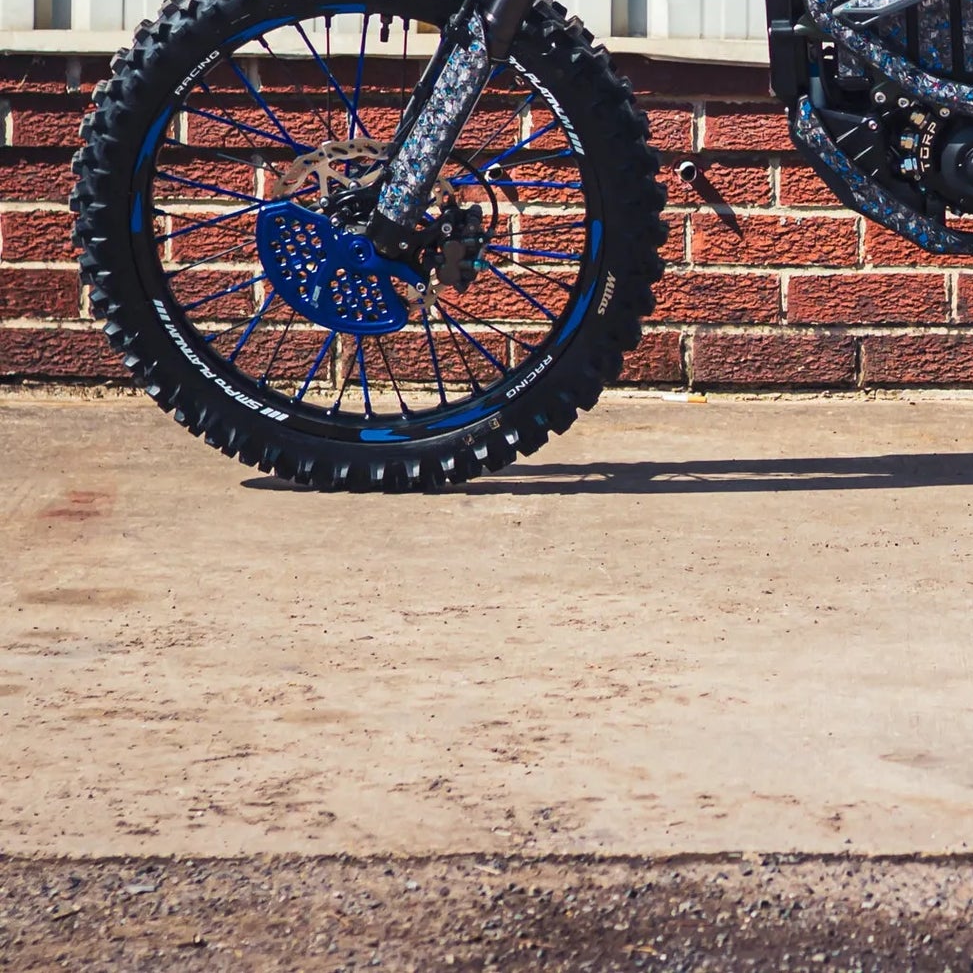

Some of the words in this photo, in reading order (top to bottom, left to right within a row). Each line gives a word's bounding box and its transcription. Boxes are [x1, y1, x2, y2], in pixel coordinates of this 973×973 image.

[174, 50, 220, 96] RACING
[523, 73, 574, 130] PLATINUM
[920, 121, 937, 173] TORP
[597, 270, 617, 316] Mitas
[164, 323, 217, 379] PLATINUM
[505, 354, 553, 399] RACING
